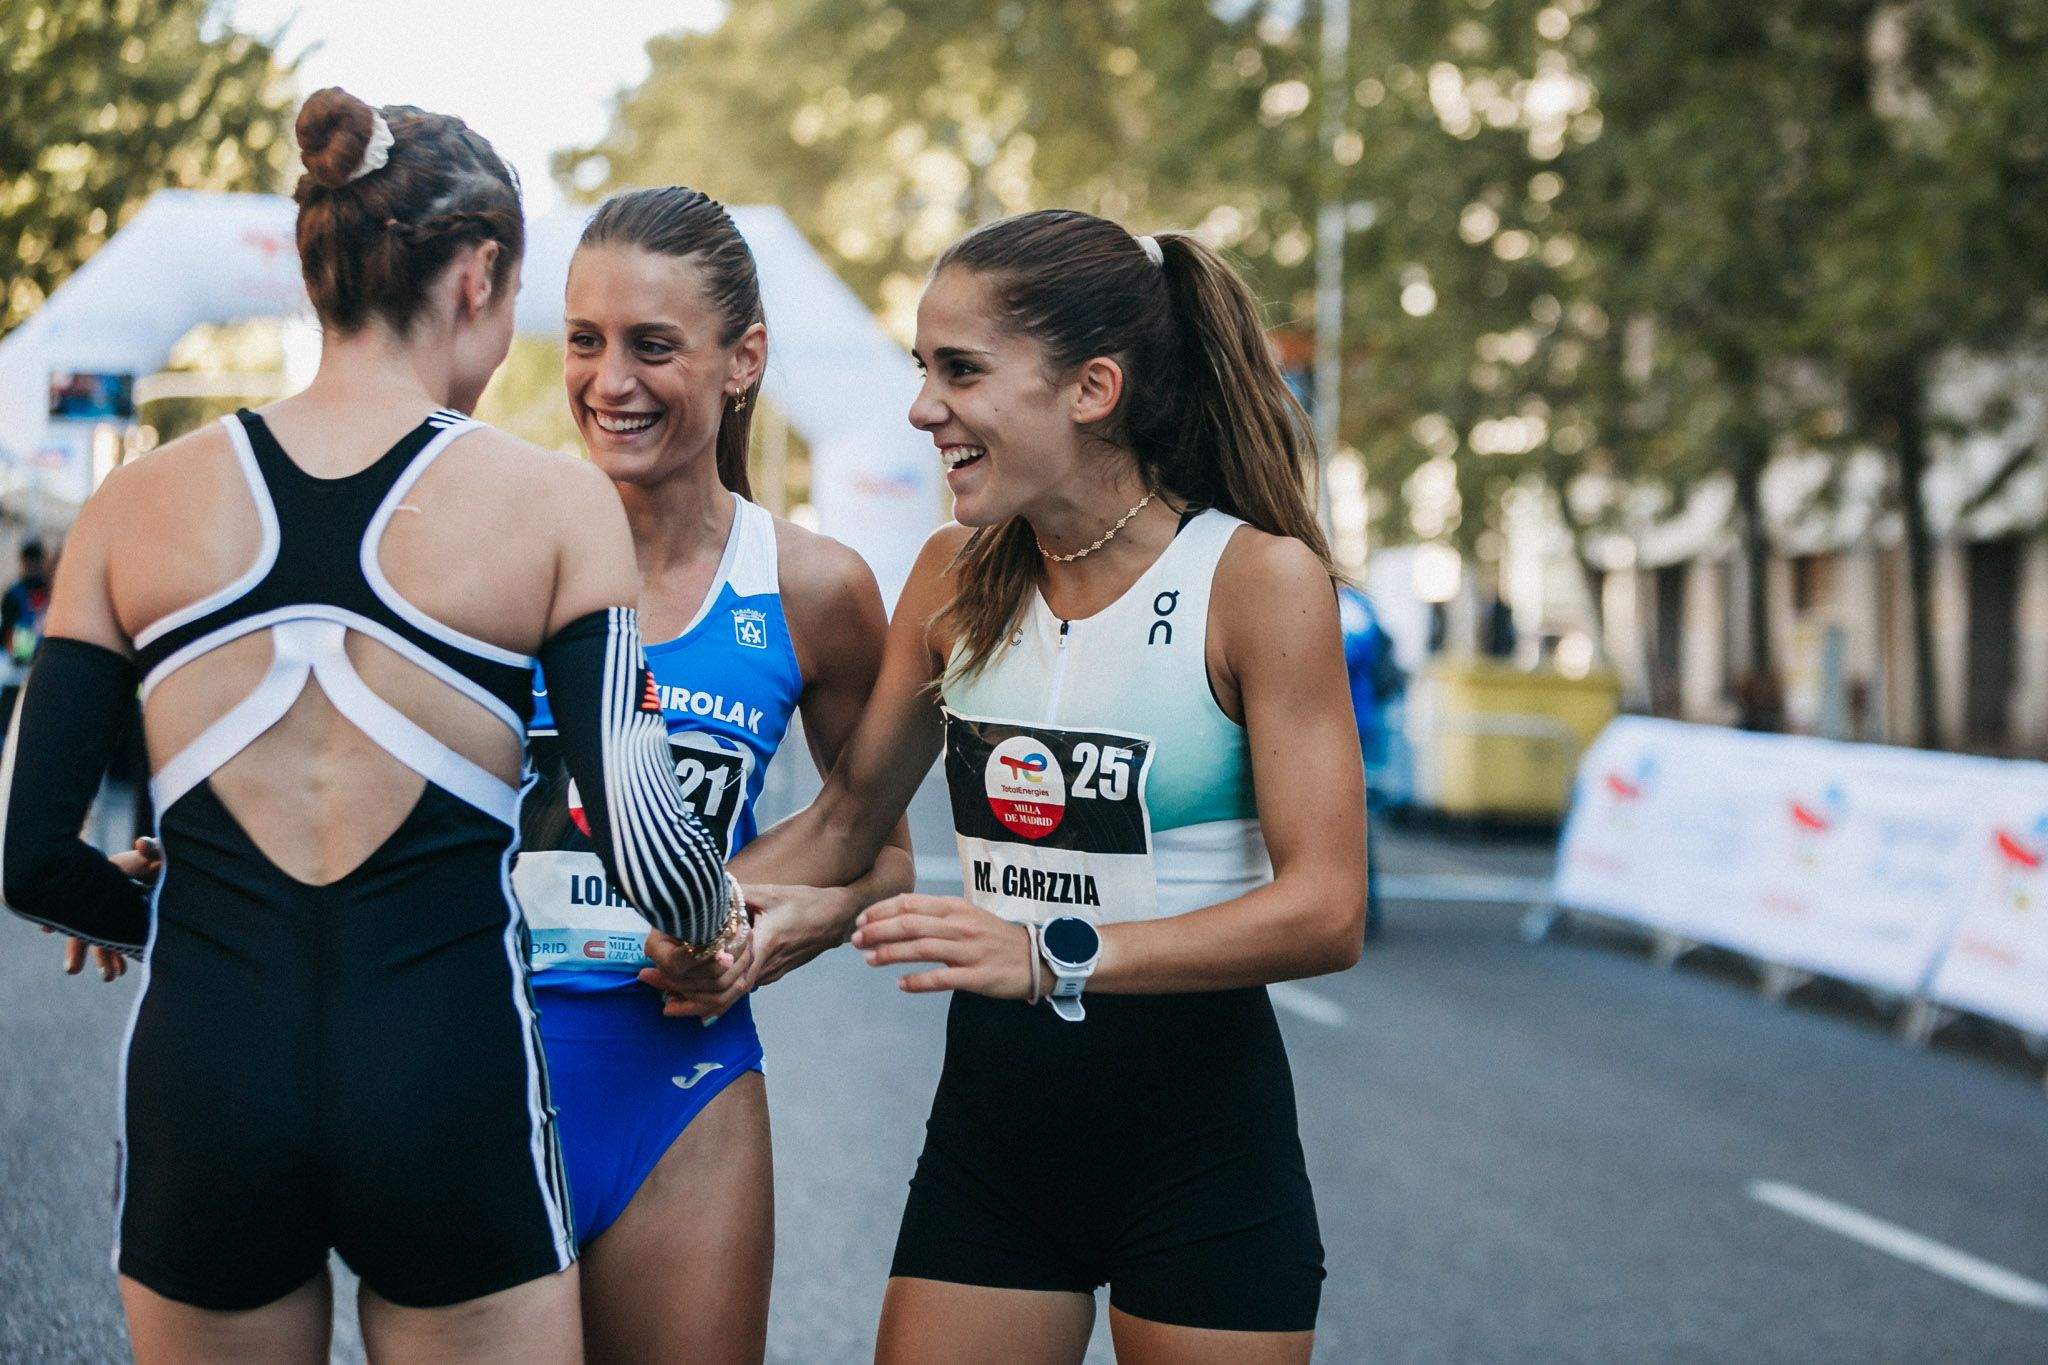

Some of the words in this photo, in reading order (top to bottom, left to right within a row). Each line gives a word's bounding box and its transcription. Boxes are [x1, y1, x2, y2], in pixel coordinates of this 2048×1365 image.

[1071, 742, 1133, 801] 25
[675, 758, 730, 816] 21
[1001, 784, 1049, 797] TotalEnergies
[1004, 813, 1019, 823] DE
[1019, 815, 1053, 827] MADRID
[1014, 803, 1041, 815] MILLA
[973, 860, 997, 893] M.
[1002, 864, 1101, 906] GARZZIA
